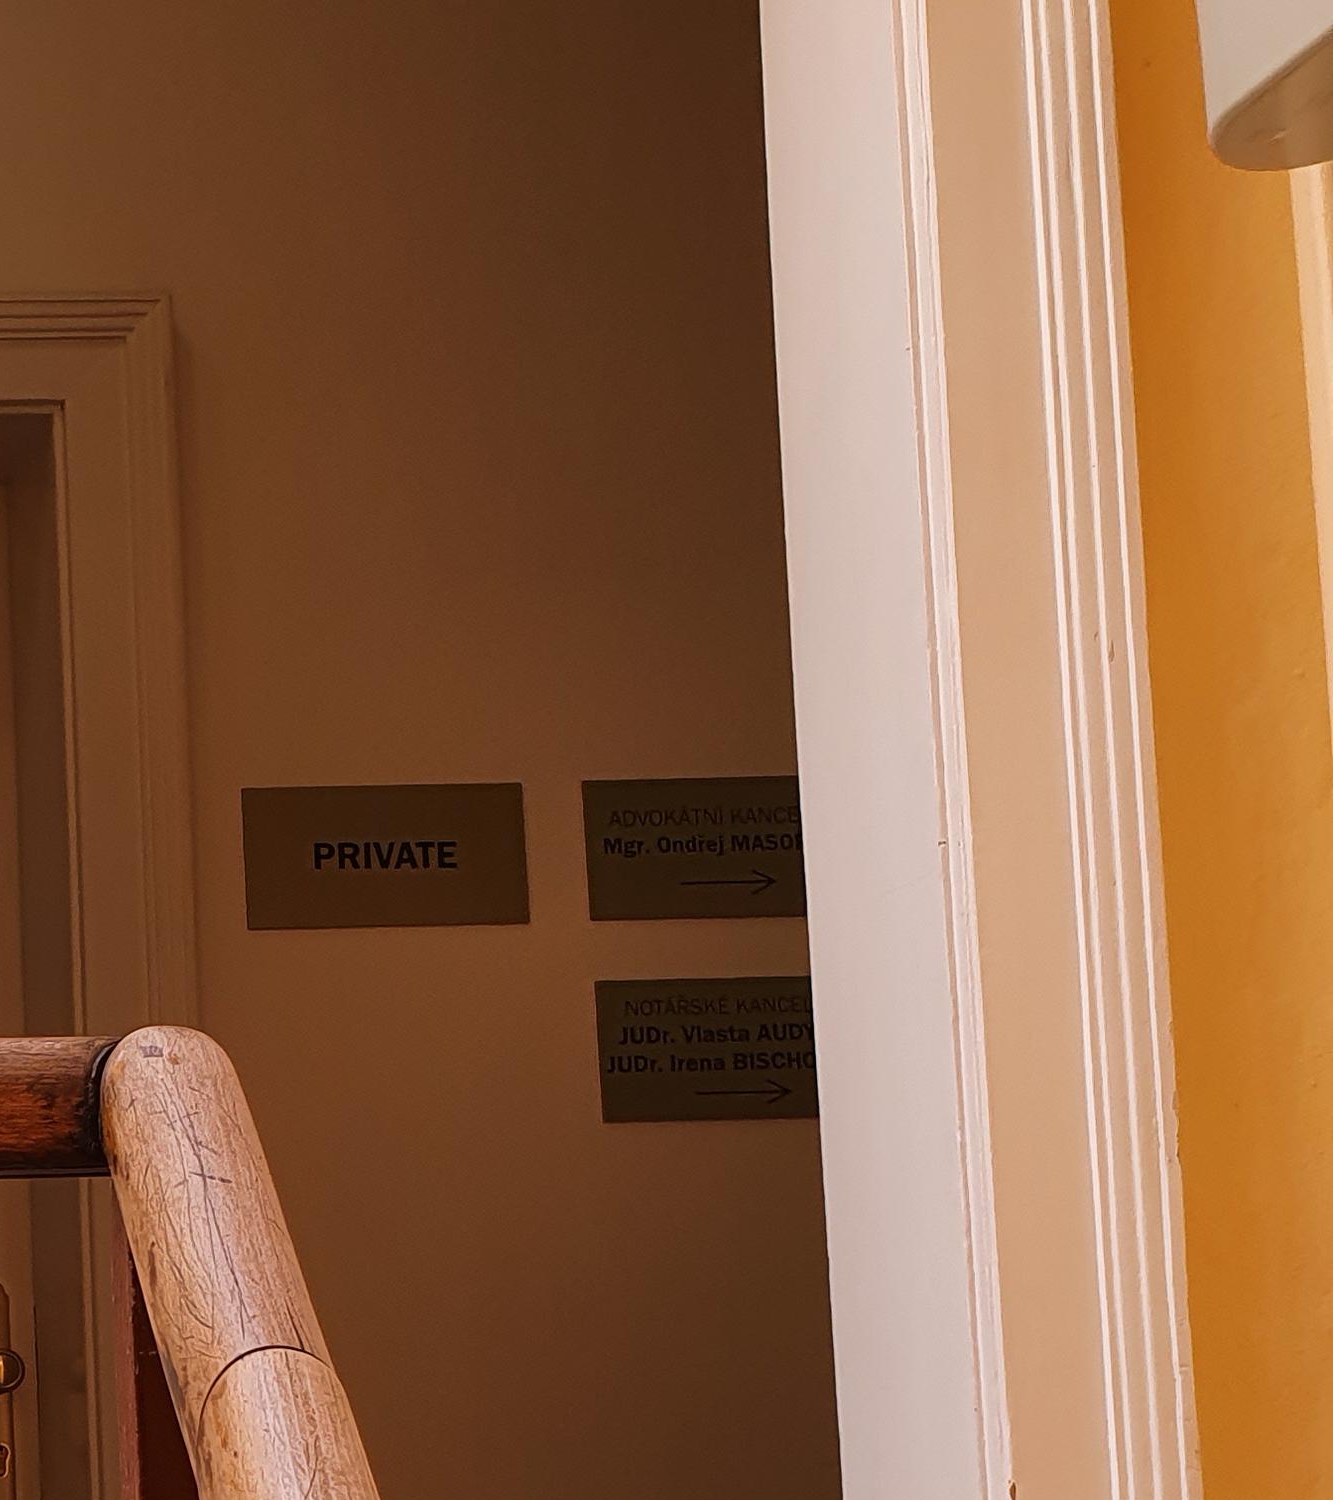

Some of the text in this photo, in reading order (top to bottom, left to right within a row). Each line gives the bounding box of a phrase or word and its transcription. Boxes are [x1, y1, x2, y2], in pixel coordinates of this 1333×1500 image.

[609, 804, 724, 827] ADVOKÁTNÍ
[313, 841, 458, 870] PRIVATE
[603, 837, 650, 858] Mgr.
[657, 833, 724, 856] Ondřej
[618, 1026, 675, 1045] JUDr.
[681, 1024, 750, 1043] Vlasta
[607, 1055, 663, 1073] JUDr.
[670, 1054, 726, 1073] Irena
